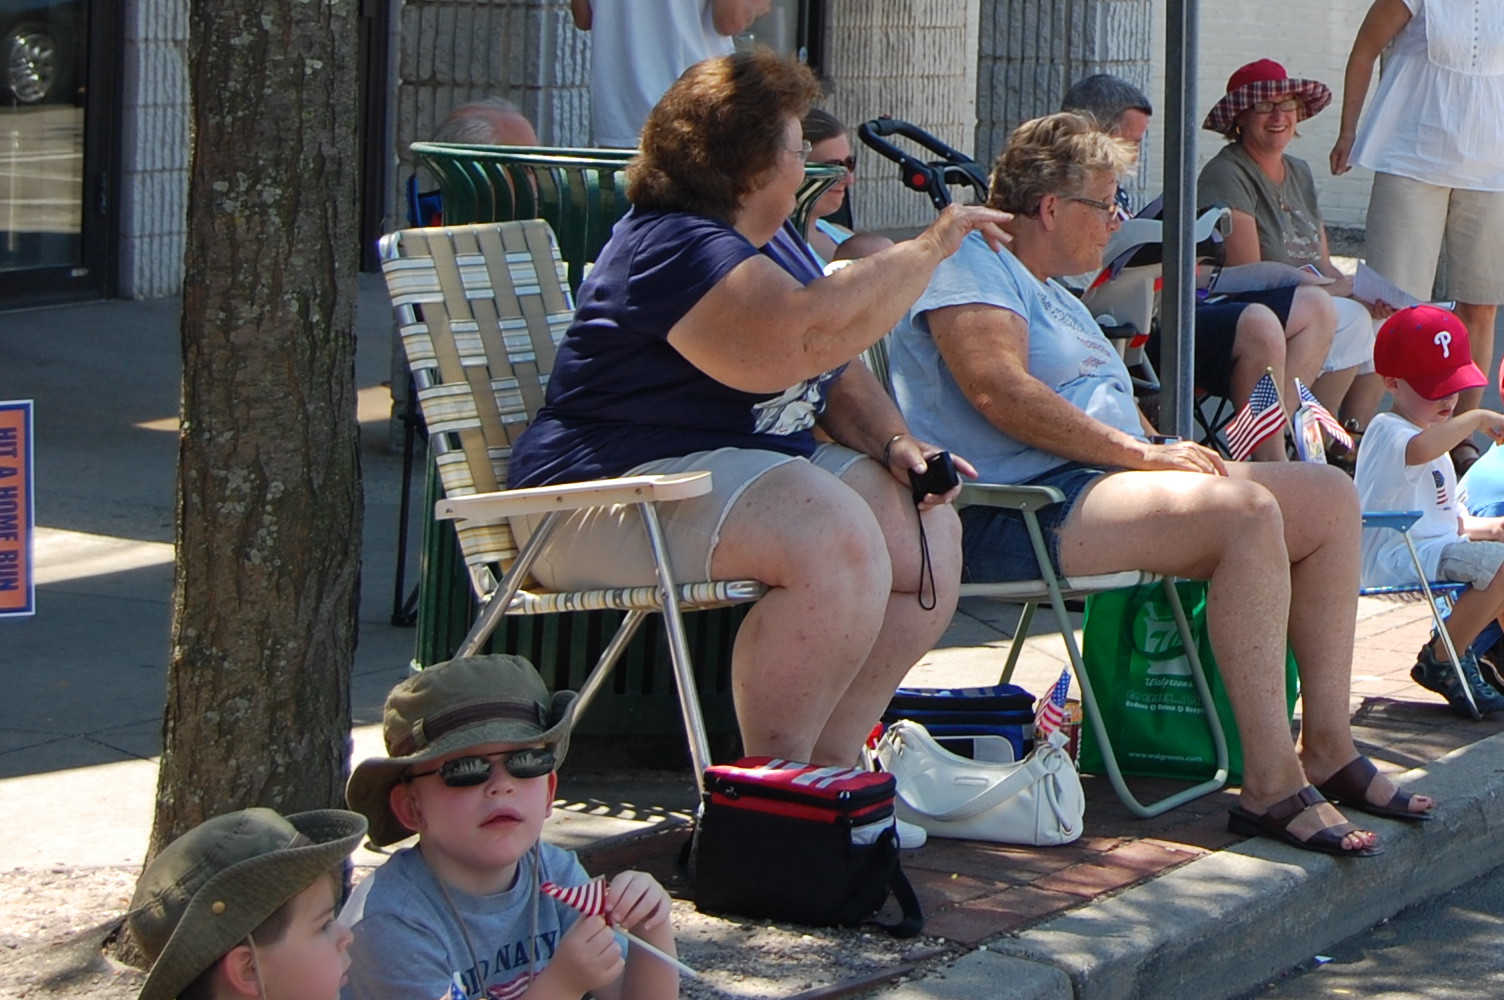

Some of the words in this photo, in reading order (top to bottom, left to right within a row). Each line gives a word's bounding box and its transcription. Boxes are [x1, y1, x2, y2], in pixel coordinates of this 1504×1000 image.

[1434, 331, 1452, 359] P
[0, 427, 18, 458] HIT
[0, 485, 19, 541] HOME
[0, 549, 19, 591] RUN
[1145, 677, 1194, 688] Walgreens
